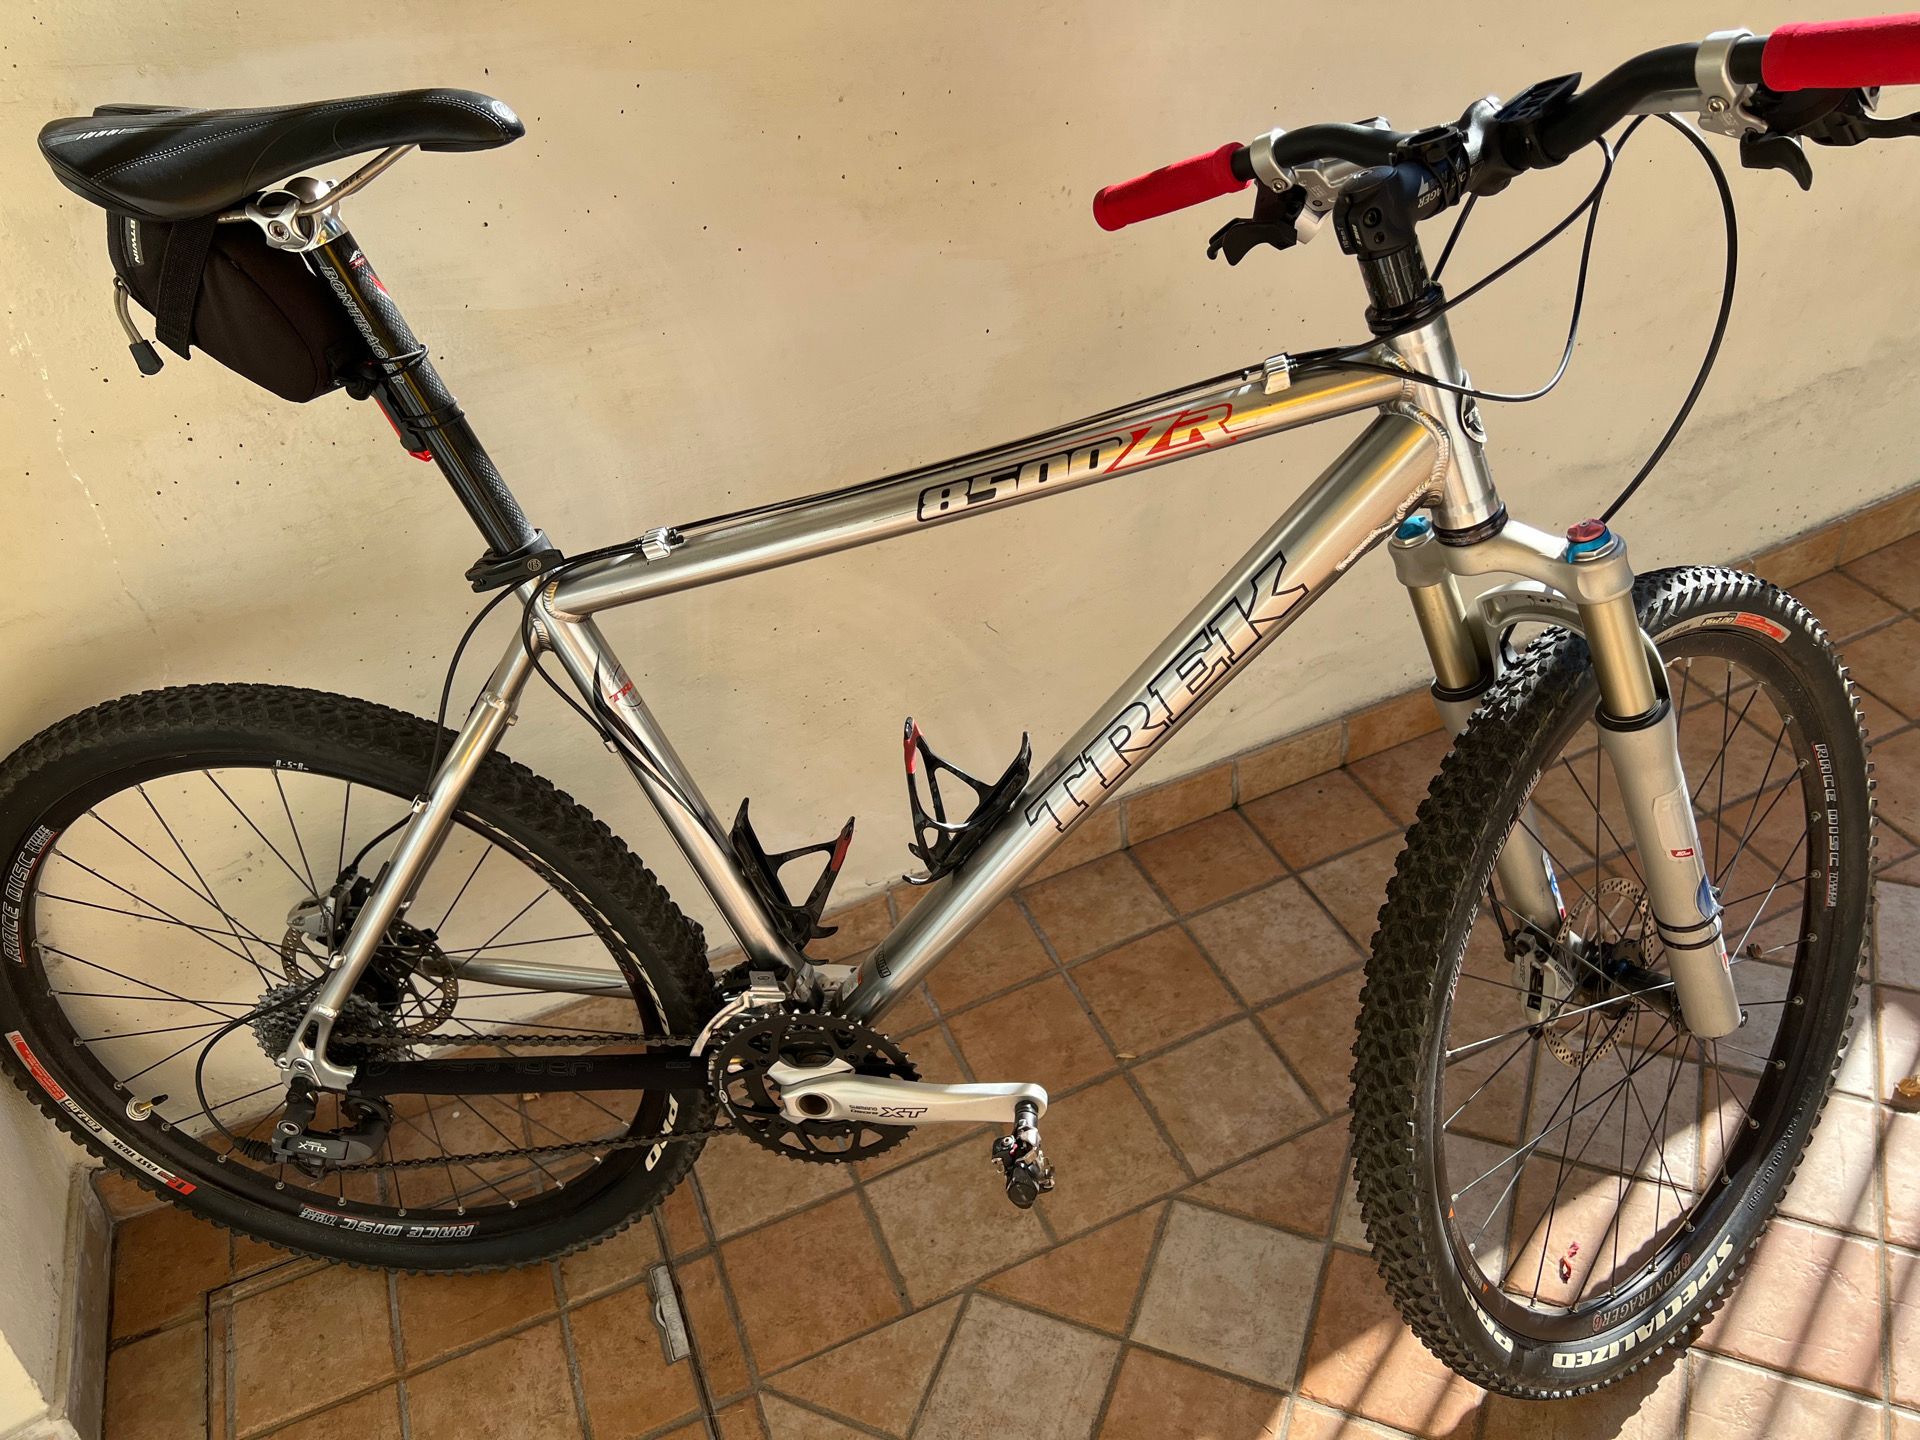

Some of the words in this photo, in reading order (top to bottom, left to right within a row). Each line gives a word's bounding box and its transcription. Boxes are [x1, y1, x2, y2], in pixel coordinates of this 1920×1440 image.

[1025, 551, 1309, 833] TREK
[1827, 808, 1840, 867] DISC
[12, 850, 35, 903] DISC
[2, 902, 23, 964] RACE
[879, 1107, 929, 1119] XT
[111, 1138, 136, 1158] TRAK
[298, 1142, 328, 1154] XTR
[340, 1218, 404, 1236] DISC
[407, 1225, 475, 1238] RACE
[1462, 1281, 1514, 1353] PRO
[1553, 1234, 1734, 1369] SPECIALIZED
[1603, 1257, 1683, 1328] BONTRAGER
